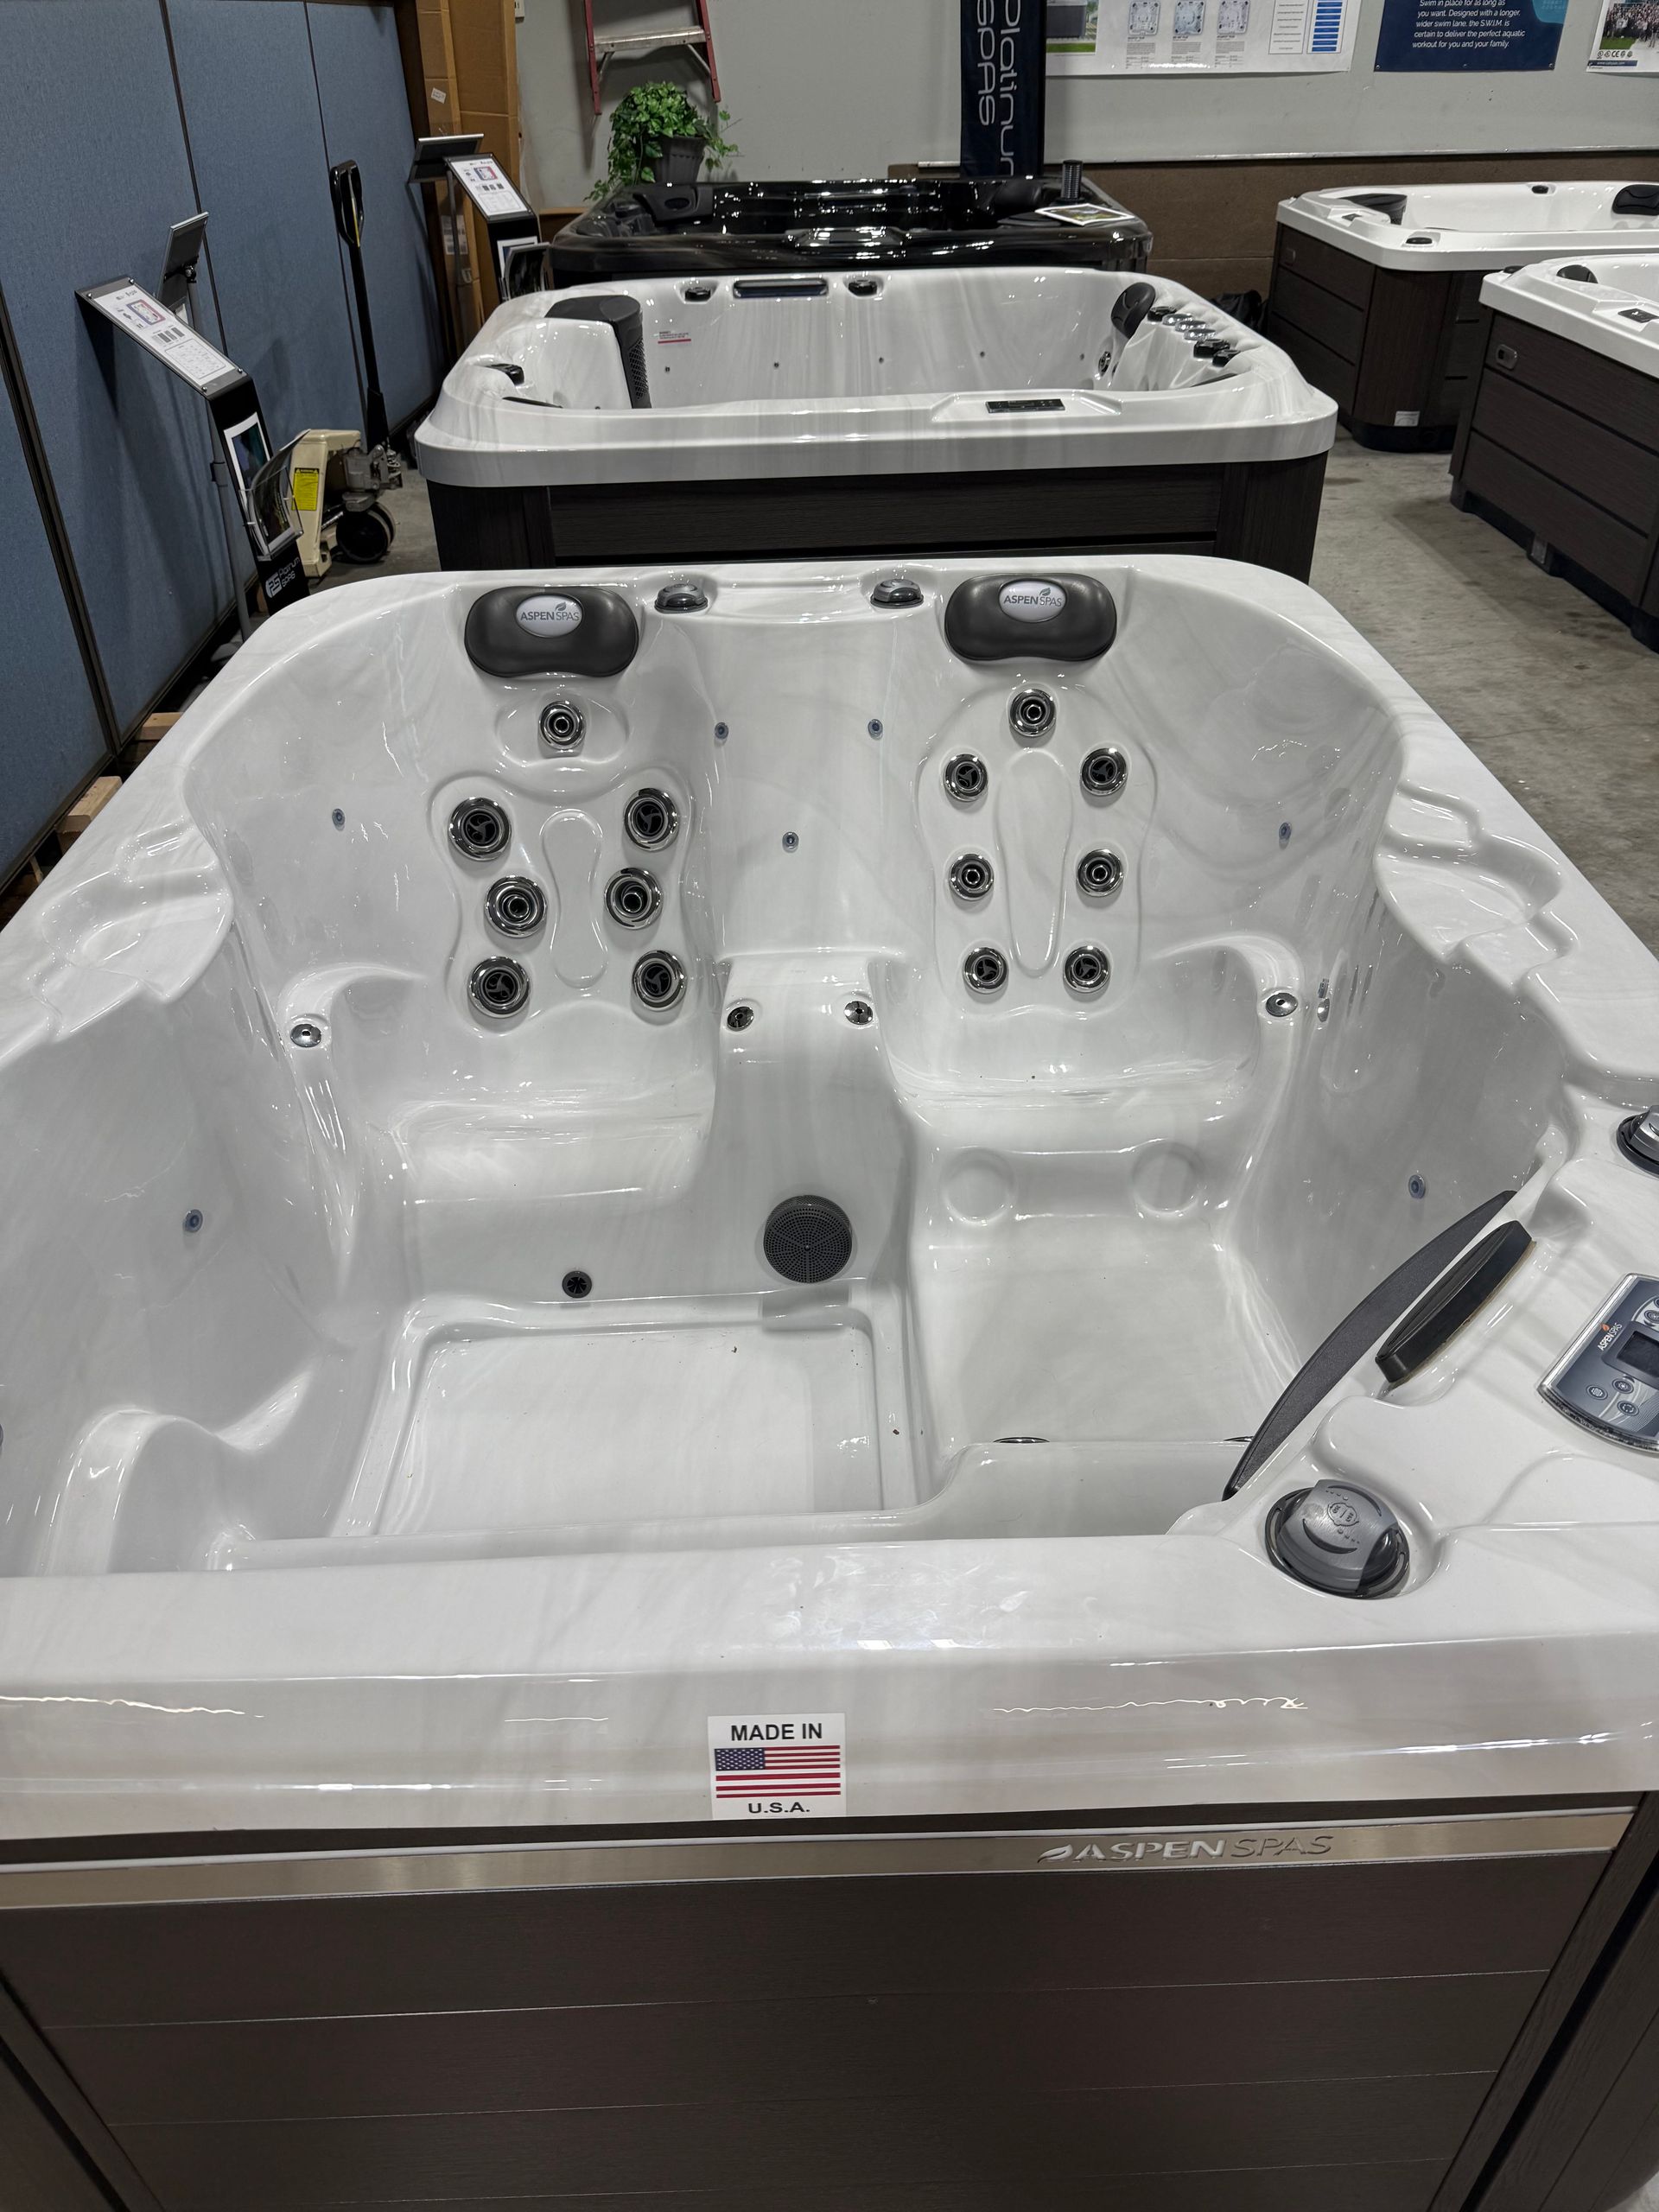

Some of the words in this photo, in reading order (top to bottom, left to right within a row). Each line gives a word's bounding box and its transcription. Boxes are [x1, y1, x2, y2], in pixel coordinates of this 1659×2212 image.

[1417, 10, 1429, 18] you
[1448, 9, 1478, 17] Designed
[1478, 29, 1501, 38] perfect
[1502, 29, 1526, 38] aquatic
[1448, 41, 1460, 49] you
[1474, 41, 1488, 49] your
[1003, 594, 1039, 605] ASPEN
[1039, 596, 1062, 607] SPAS
[520, 611, 555, 621] ASPEN
[556, 611, 580, 621] SPAS
[1597, 1332, 1614, 1351] ASPEN
[731, 1723, 795, 1741] MADE
[802, 1722, 823, 1739] IN
[748, 1802, 810, 1814] U.S.A.
[1072, 1839, 1228, 1862] ASPEN
[1230, 1835, 1334, 1859] SPAS
